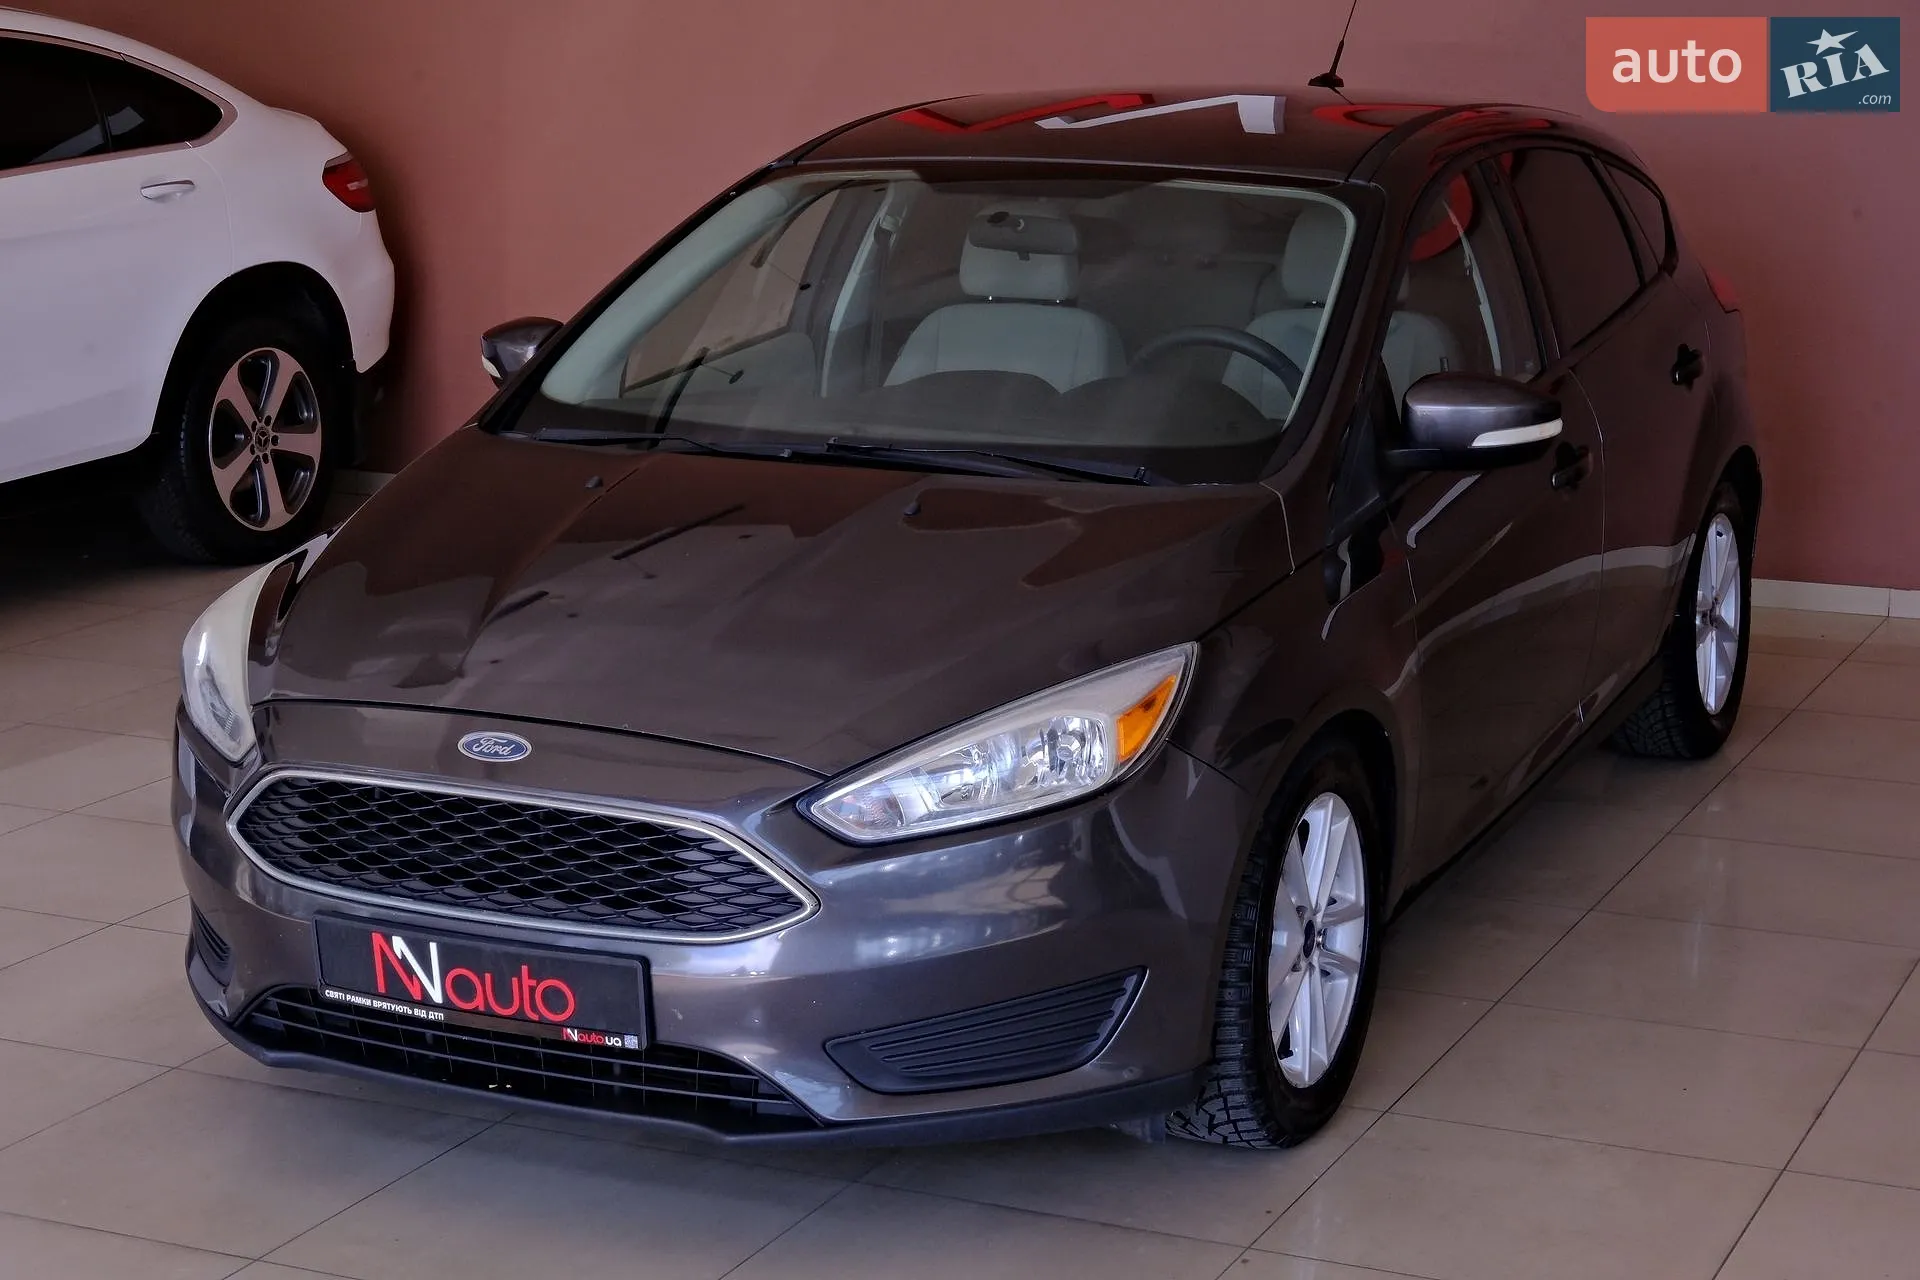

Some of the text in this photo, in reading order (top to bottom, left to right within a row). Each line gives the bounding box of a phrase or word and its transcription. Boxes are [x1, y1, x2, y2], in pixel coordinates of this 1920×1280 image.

[472, 737, 516, 756] Ford
[325, 989, 444, 1021] СВЯТІ РАМКИ ВРЯТУЮТЬ ВІД ДТП
